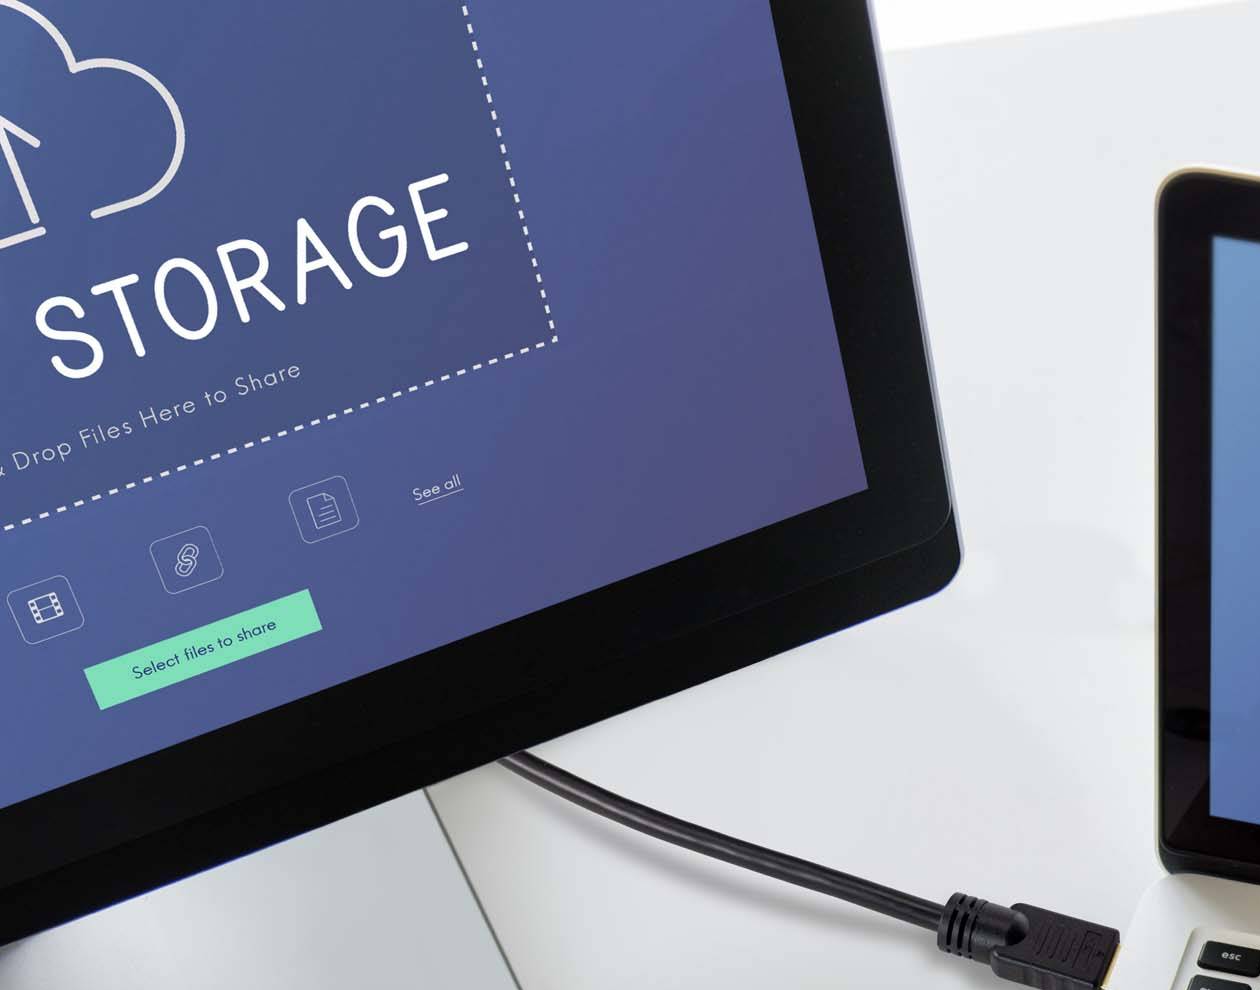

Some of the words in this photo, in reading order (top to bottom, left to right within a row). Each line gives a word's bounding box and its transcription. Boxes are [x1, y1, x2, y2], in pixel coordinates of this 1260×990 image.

[35, 173, 469, 378] STORAGE
[12, 442, 72, 470] Drop
[78, 424, 132, 448] Files
[139, 401, 196, 428] Here
[202, 390, 227, 406] to
[234, 365, 300, 395] Share
[413, 486, 440, 501] See
[444, 474, 461, 489] all
[132, 653, 180, 679] Select
[184, 644, 215, 662] files
[217, 637, 233, 648] to
[237, 621, 277, 642] share
[1222, 952, 1241, 961] esc
